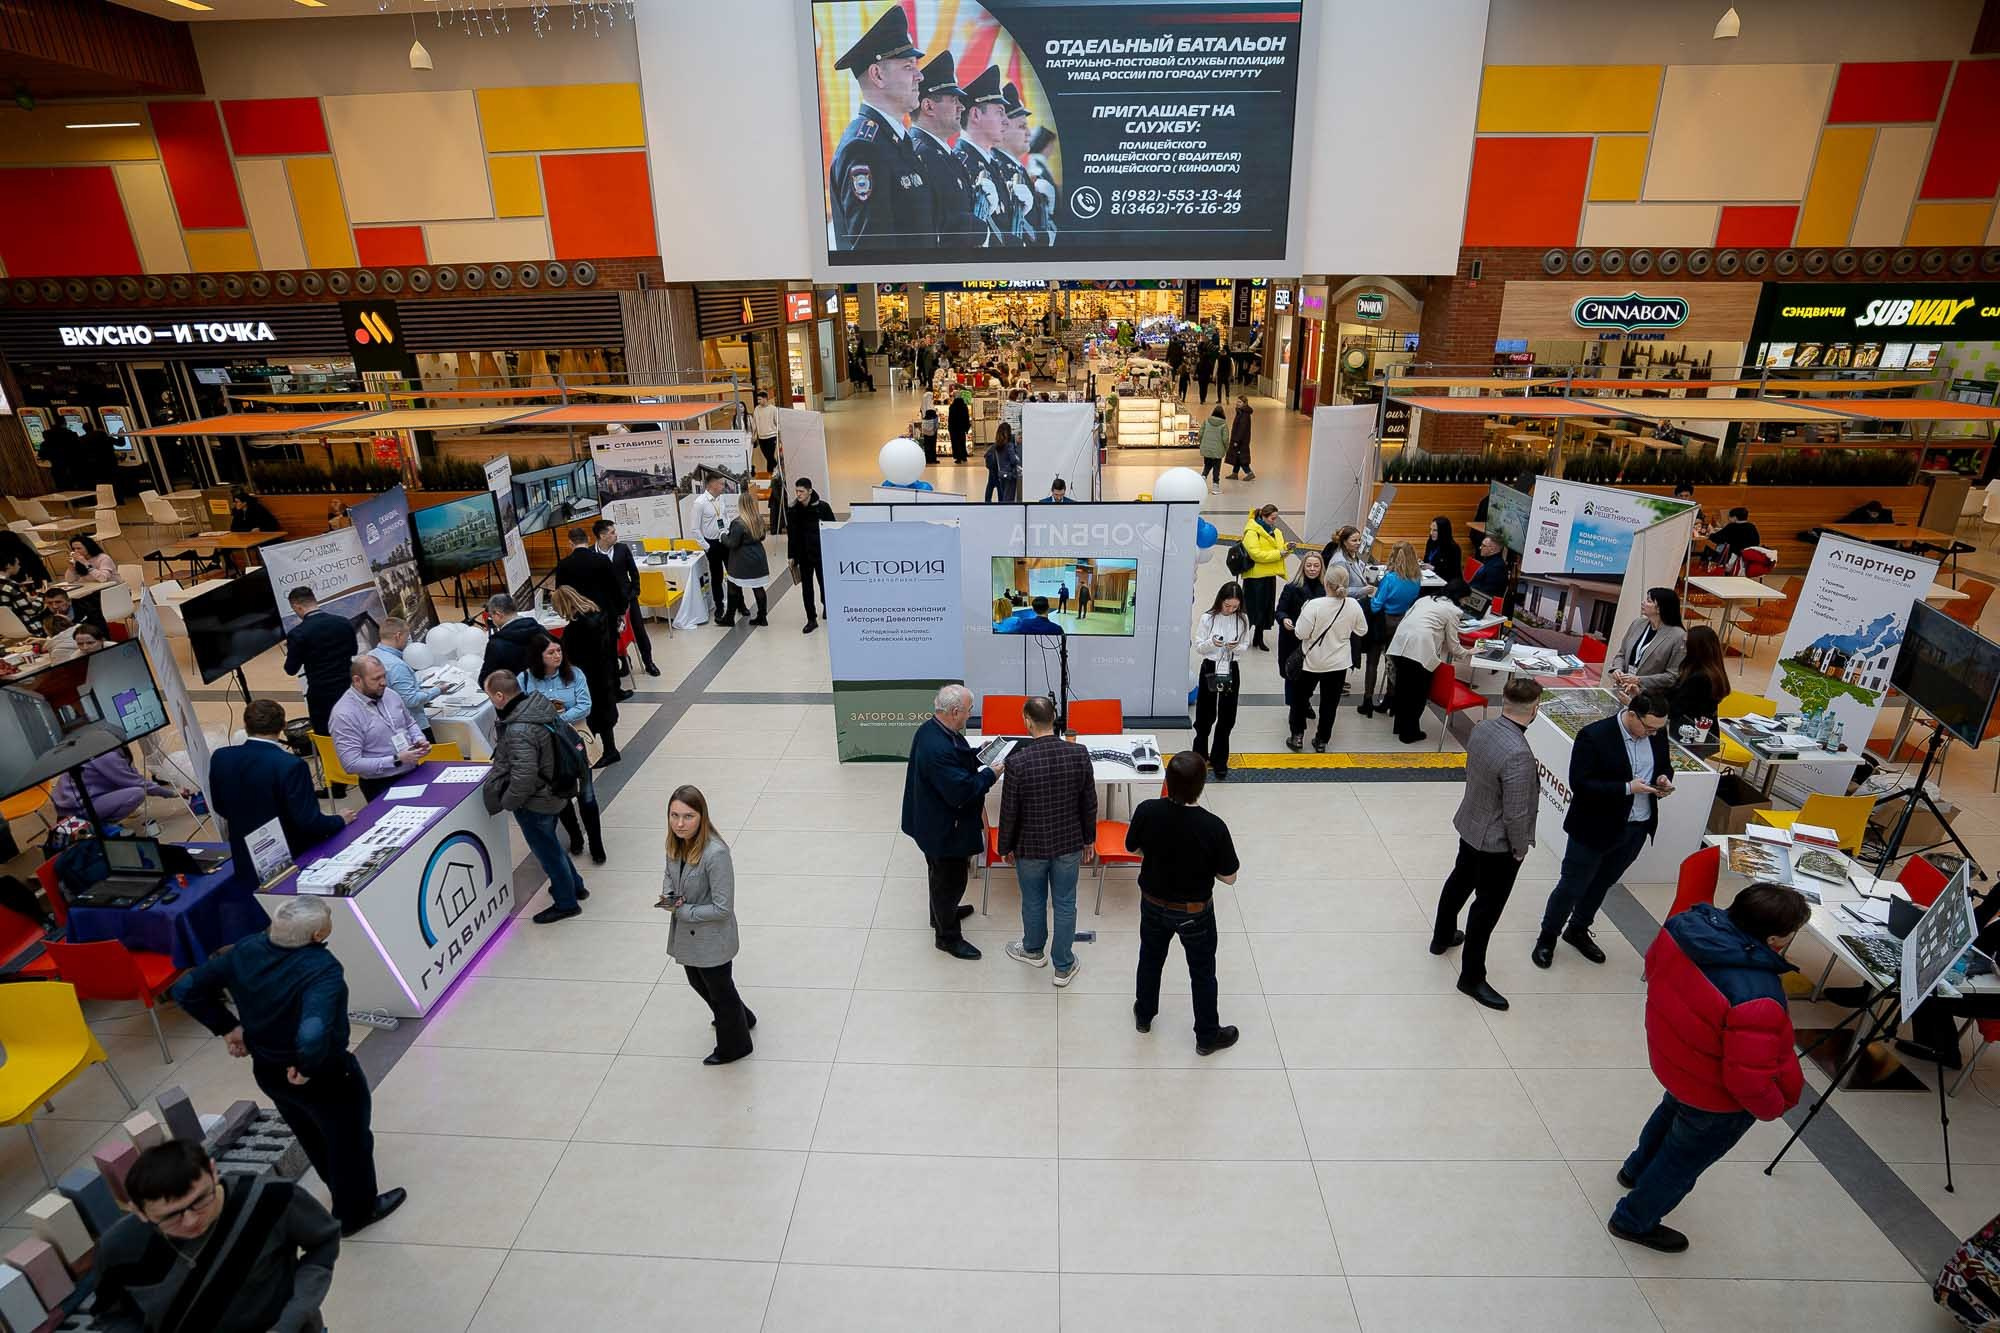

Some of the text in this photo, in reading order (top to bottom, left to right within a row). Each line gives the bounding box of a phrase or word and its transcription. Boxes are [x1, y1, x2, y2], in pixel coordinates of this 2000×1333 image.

[1045, 34, 1286, 56] ОТДЕЛЬНЫЙ БАТАЛЬОН
[1046, 55, 1285, 68] ПАТРУЛЬНО-ПОСТОВОЙ СЛУЖБЫ ПОЛИЦИИ
[1067, 68, 1262, 81] УМВД РОССИИ ПО ГОРОДУ СУРГУТУ
[1092, 104, 1236, 118] ПРИГЛАШАЕТ НА
[1125, 120, 1201, 134] СЛУЖБУ:
[1119, 139, 1207, 150] ПОЛИЦЕЙСКОГО
[1083, 151, 1171, 163] ПОЛИЦЕЙСКОГО
[1084, 163, 1172, 174] ПОЛИЦЕЙСКОГО
[1111, 189, 1242, 202] 8(982)-553-13-44
[1111, 202, 1242, 215] 8(3462)-76-16-29
[1782, 306, 1846, 317] СЭНДВИЧИ
[1856, 297, 1975, 327] SUBWAY
[59, 325, 152, 346] ВКУСНО
[193, 322, 277, 343] ТОЧКА
[614, 439, 663, 449] СТАБИЛИС
[1594, 510, 1641, 524] РЕШЕТНИКОВА
[278, 554, 364, 585] КОГДА ХОЧЕТСЯ
[840, 560, 944, 575] ИСТОРИЯ
[1845, 553, 1916, 582] партнер
[320, 574, 348, 590] ДОМ
[851, 712, 904, 721] ЗАГОРОД
[421, 884, 509, 991] ГУДВИЛЛ
